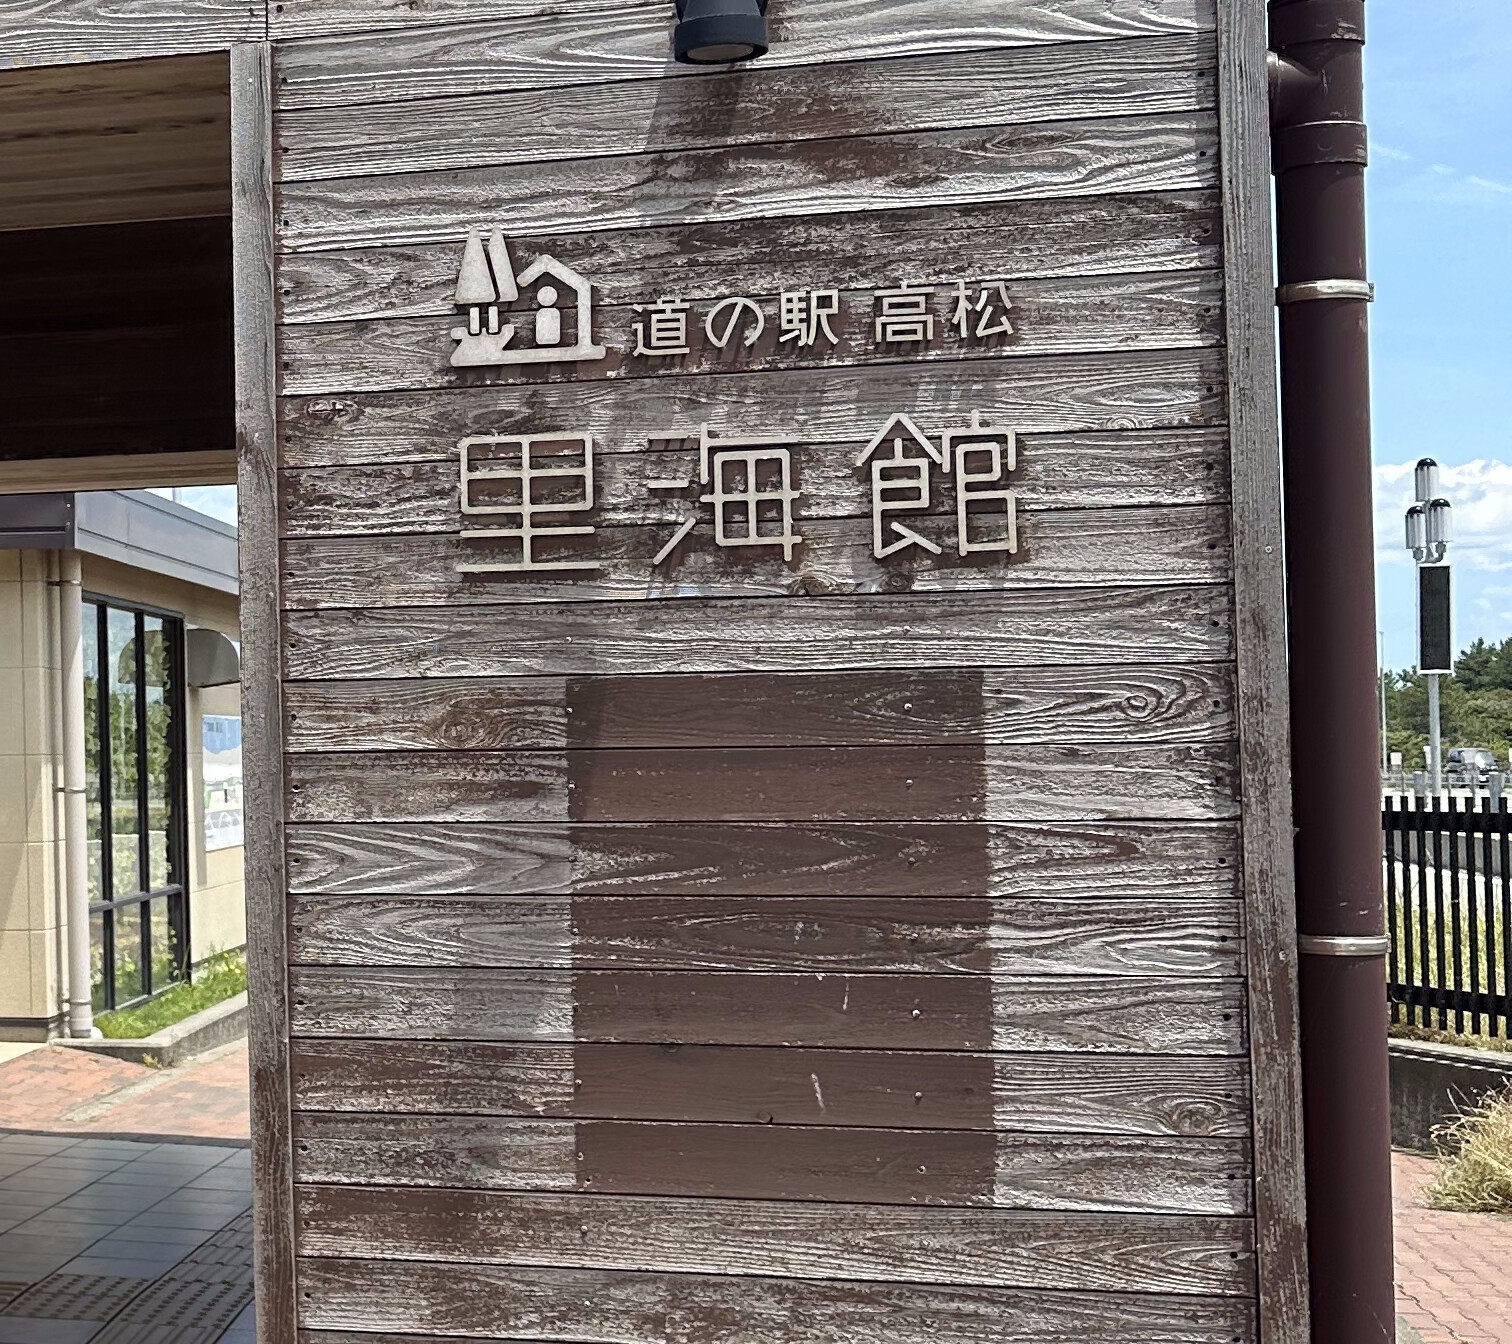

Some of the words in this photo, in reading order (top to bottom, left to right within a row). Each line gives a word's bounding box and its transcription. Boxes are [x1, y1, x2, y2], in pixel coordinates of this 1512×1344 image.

[631, 288, 840, 358] 道の駅
[874, 279, 1016, 343] 高松
[456, 409, 1019, 574] 里海館
